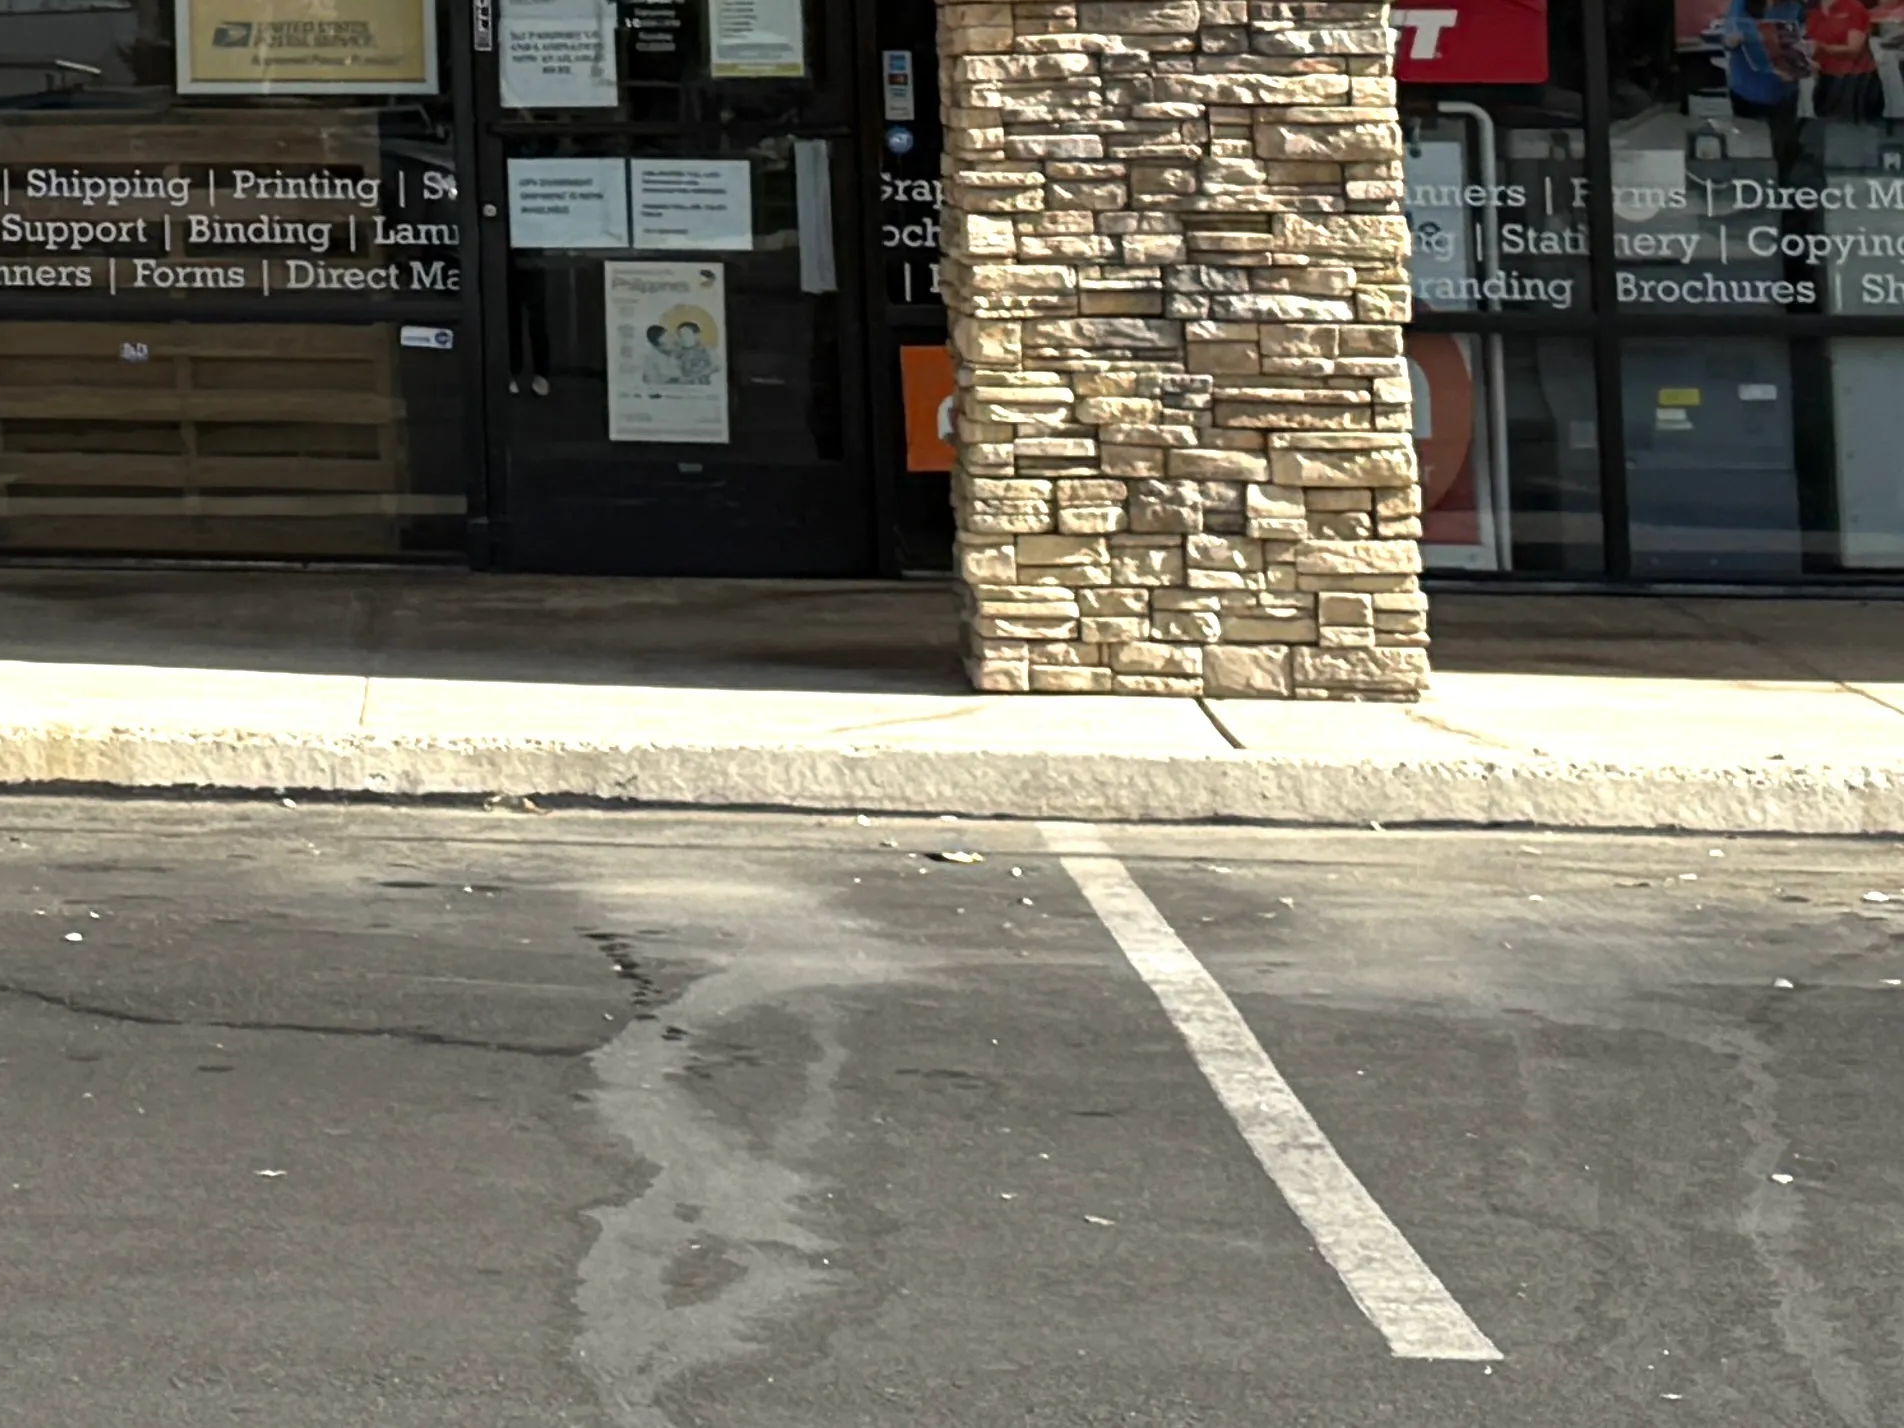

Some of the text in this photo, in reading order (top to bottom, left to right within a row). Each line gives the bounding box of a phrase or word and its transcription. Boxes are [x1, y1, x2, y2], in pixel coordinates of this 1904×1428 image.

[26, 168, 191, 206] Shipping
[232, 170, 381, 208] Printing
[1732, 178, 1856, 210] Direct
[1, 213, 148, 250] Support
[188, 214, 332, 252] Binding
[132, 257, 246, 288] Forms
[285, 259, 400, 291] Direct
[1417, 270, 1574, 309] randing
[1616, 271, 1817, 304] Brochures
